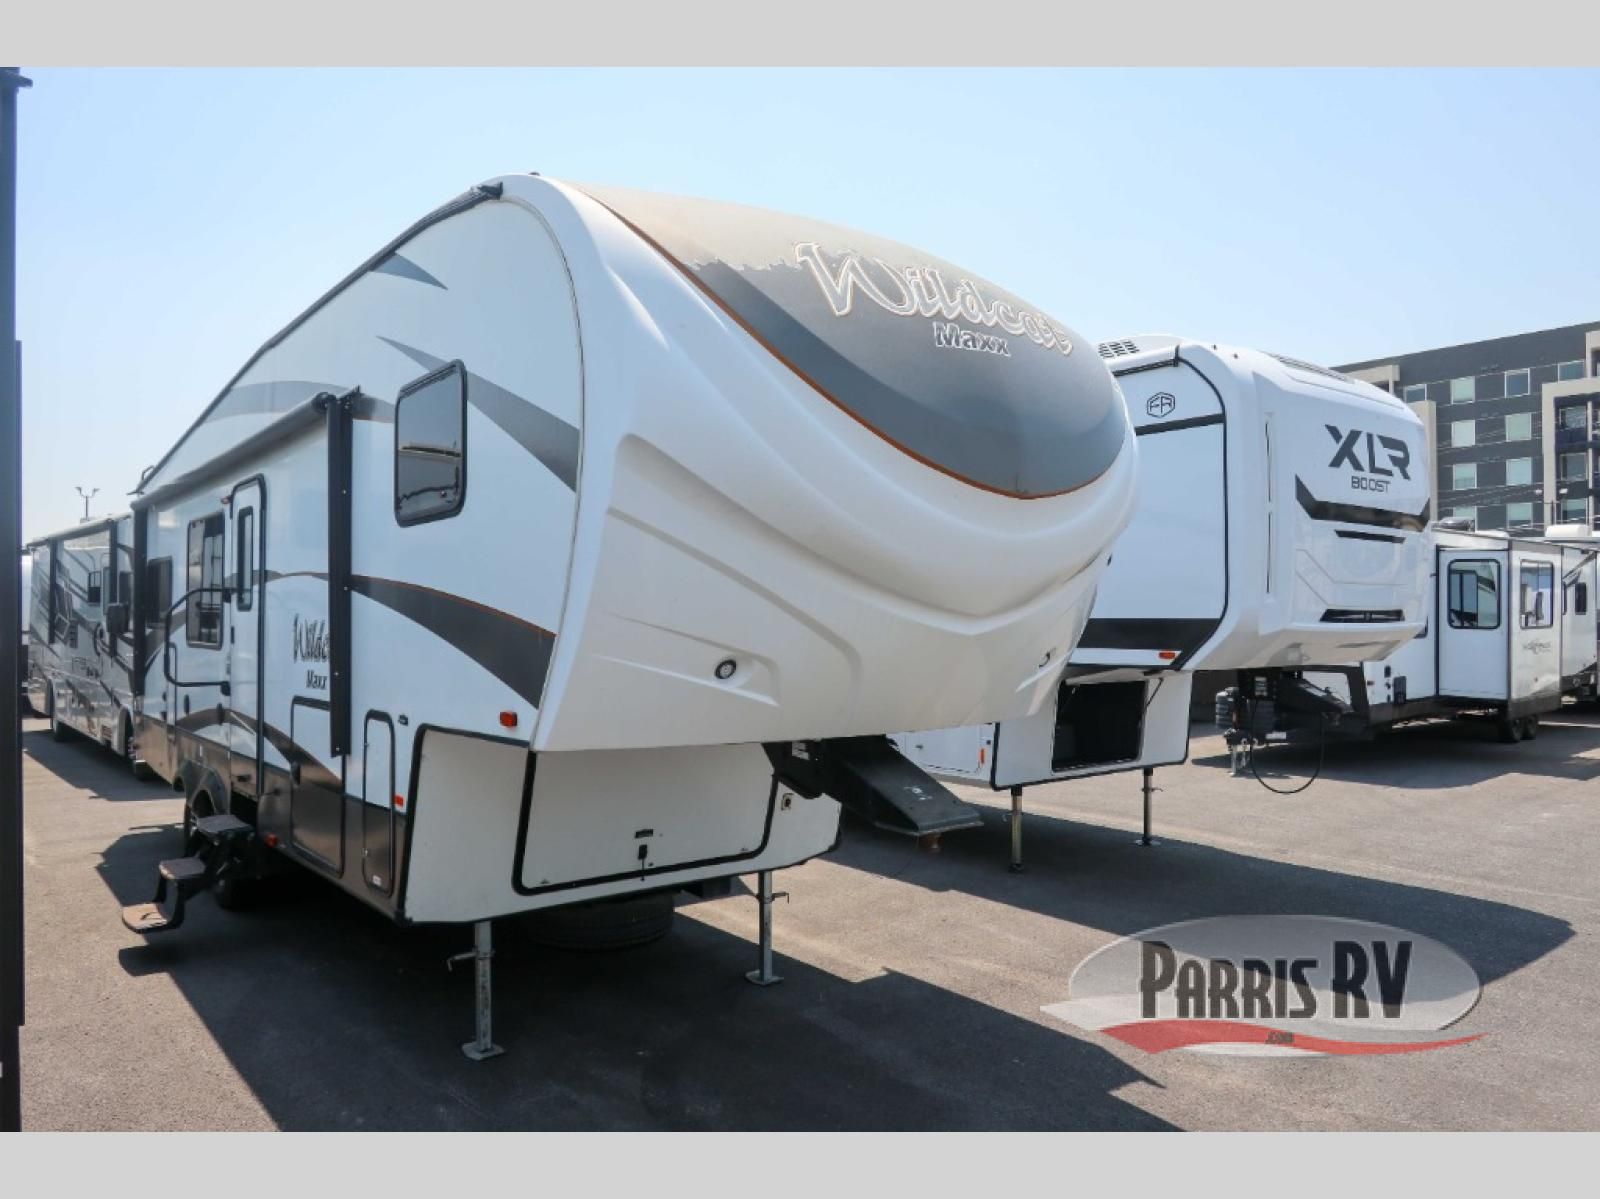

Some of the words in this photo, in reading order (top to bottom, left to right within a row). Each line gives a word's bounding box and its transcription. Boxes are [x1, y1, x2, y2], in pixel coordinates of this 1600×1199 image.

[795, 242, 1073, 355] Wildcat
[933, 322, 1011, 356] Maxx
[1325, 424, 1411, 480] XLR
[1351, 475, 1391, 493] BOOST
